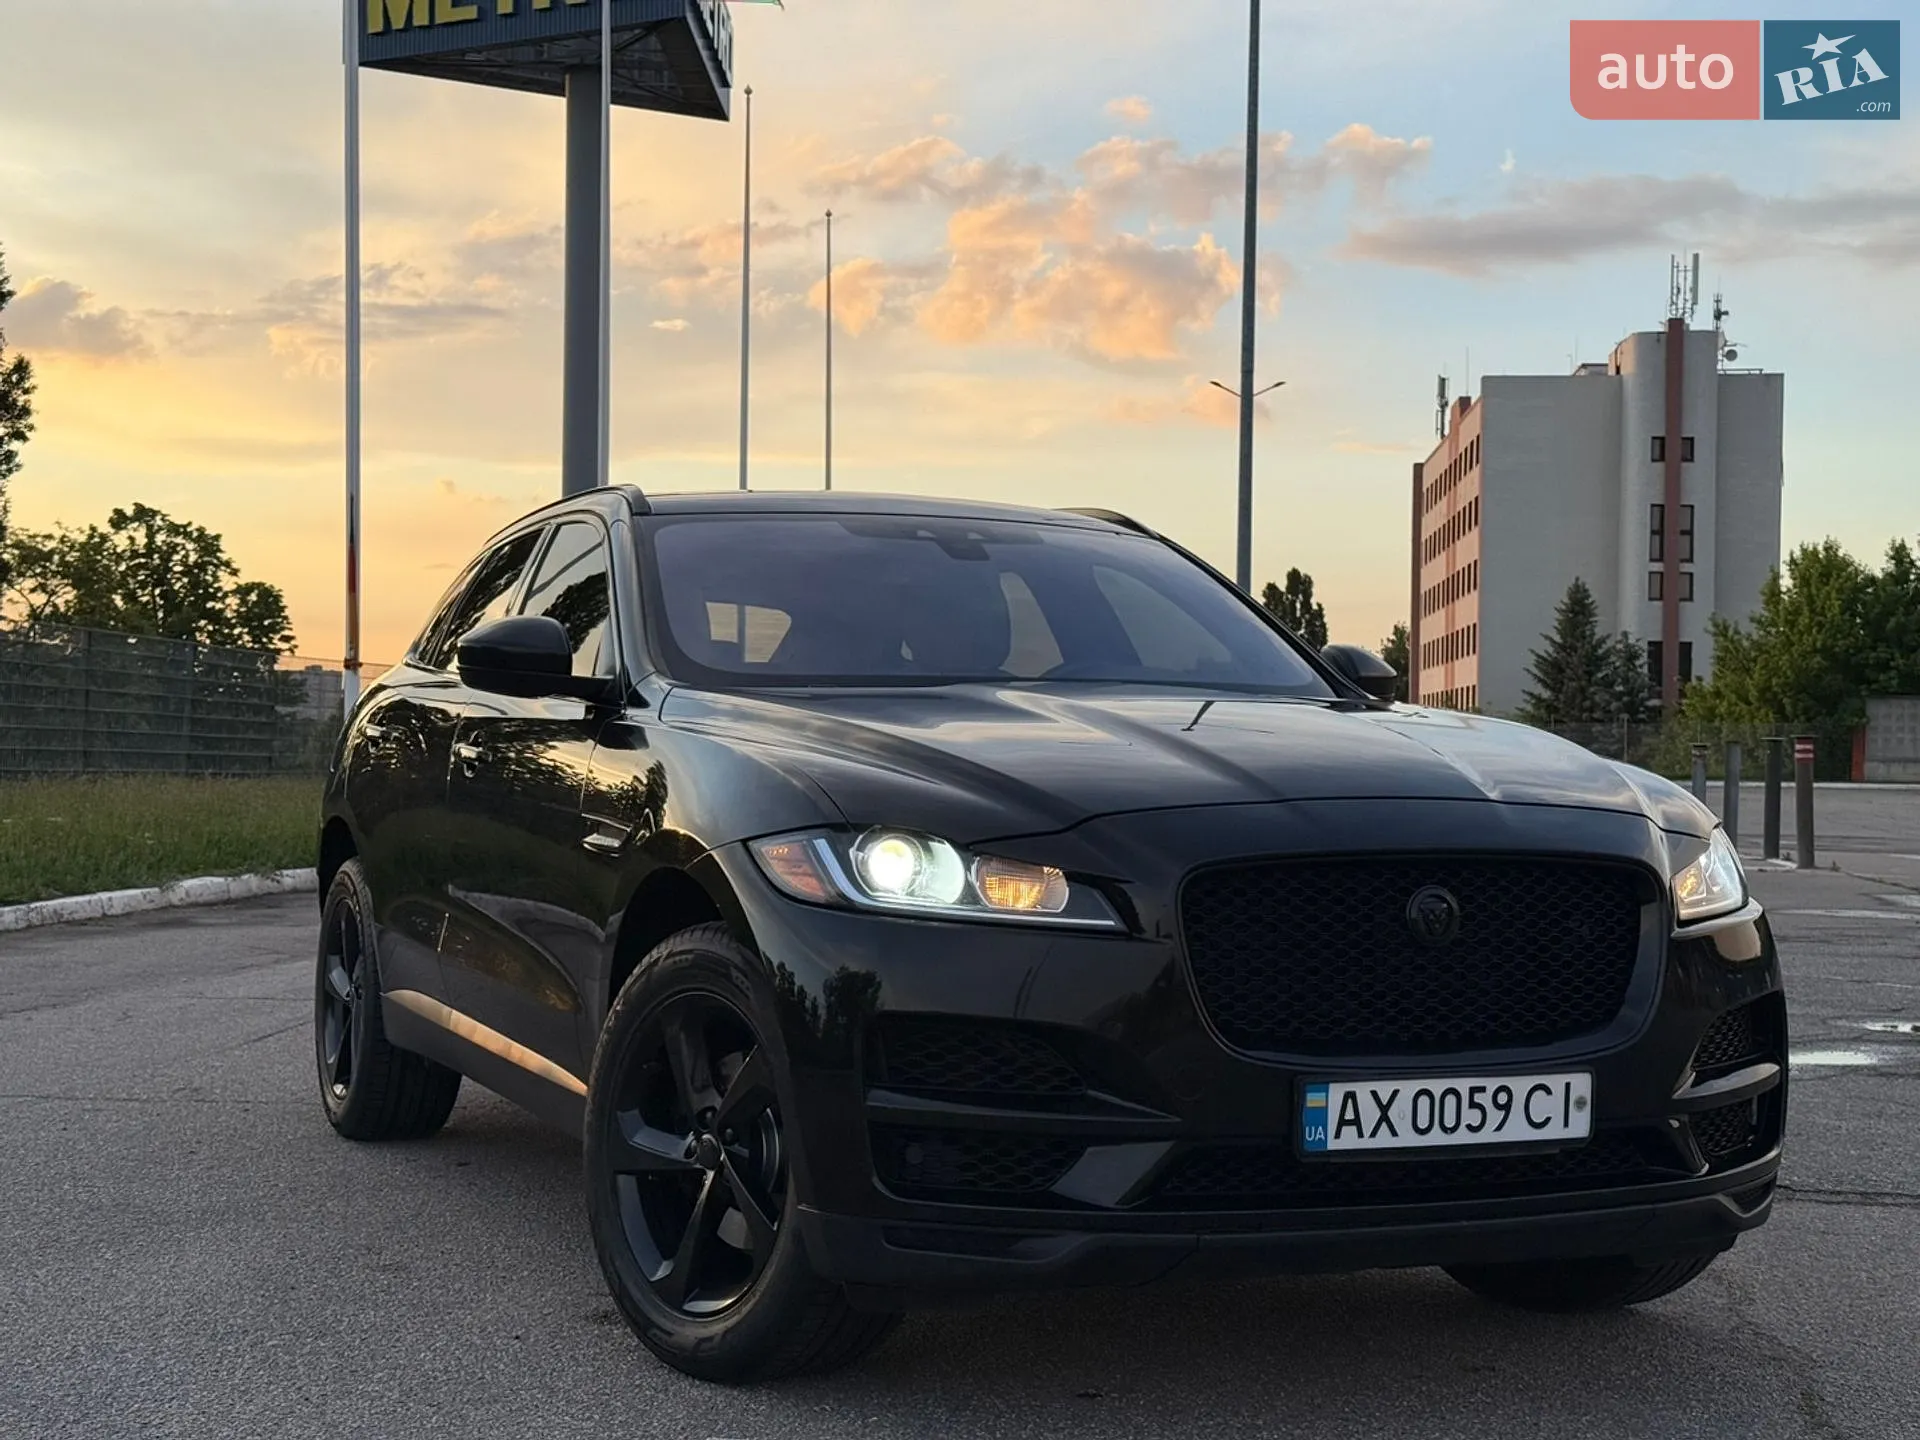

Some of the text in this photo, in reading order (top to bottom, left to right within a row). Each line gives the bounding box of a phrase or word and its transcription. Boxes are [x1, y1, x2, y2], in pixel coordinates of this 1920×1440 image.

[1333, 1089, 1400, 1139] AX
[1411, 1085, 1514, 1136] 0059
[1304, 1125, 1325, 1141] UA
